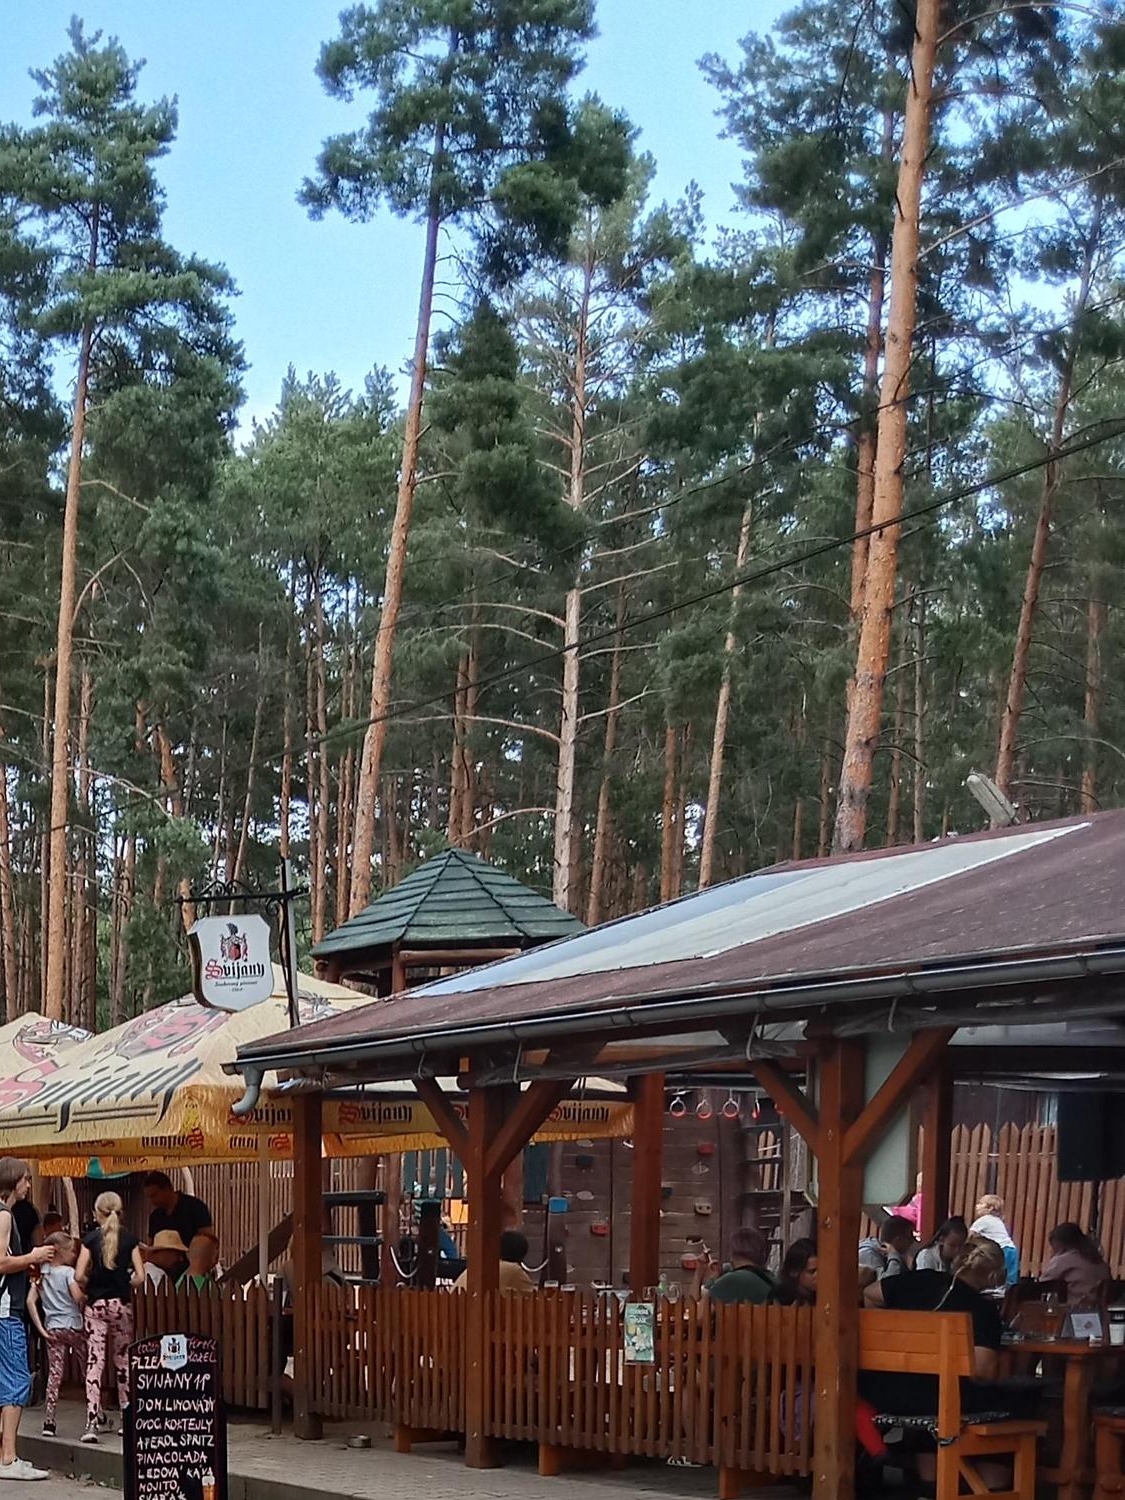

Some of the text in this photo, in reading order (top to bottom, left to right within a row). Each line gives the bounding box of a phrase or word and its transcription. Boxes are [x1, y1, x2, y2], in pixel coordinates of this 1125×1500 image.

[205, 959, 265, 979] Svijany
[339, 1101, 412, 1125] Svijany
[137, 1373, 192, 1390] SVIJANY
[164, 1417, 213, 1433] KOKTEJLY
[137, 1434, 215, 1450] APEROL SPRITZ
